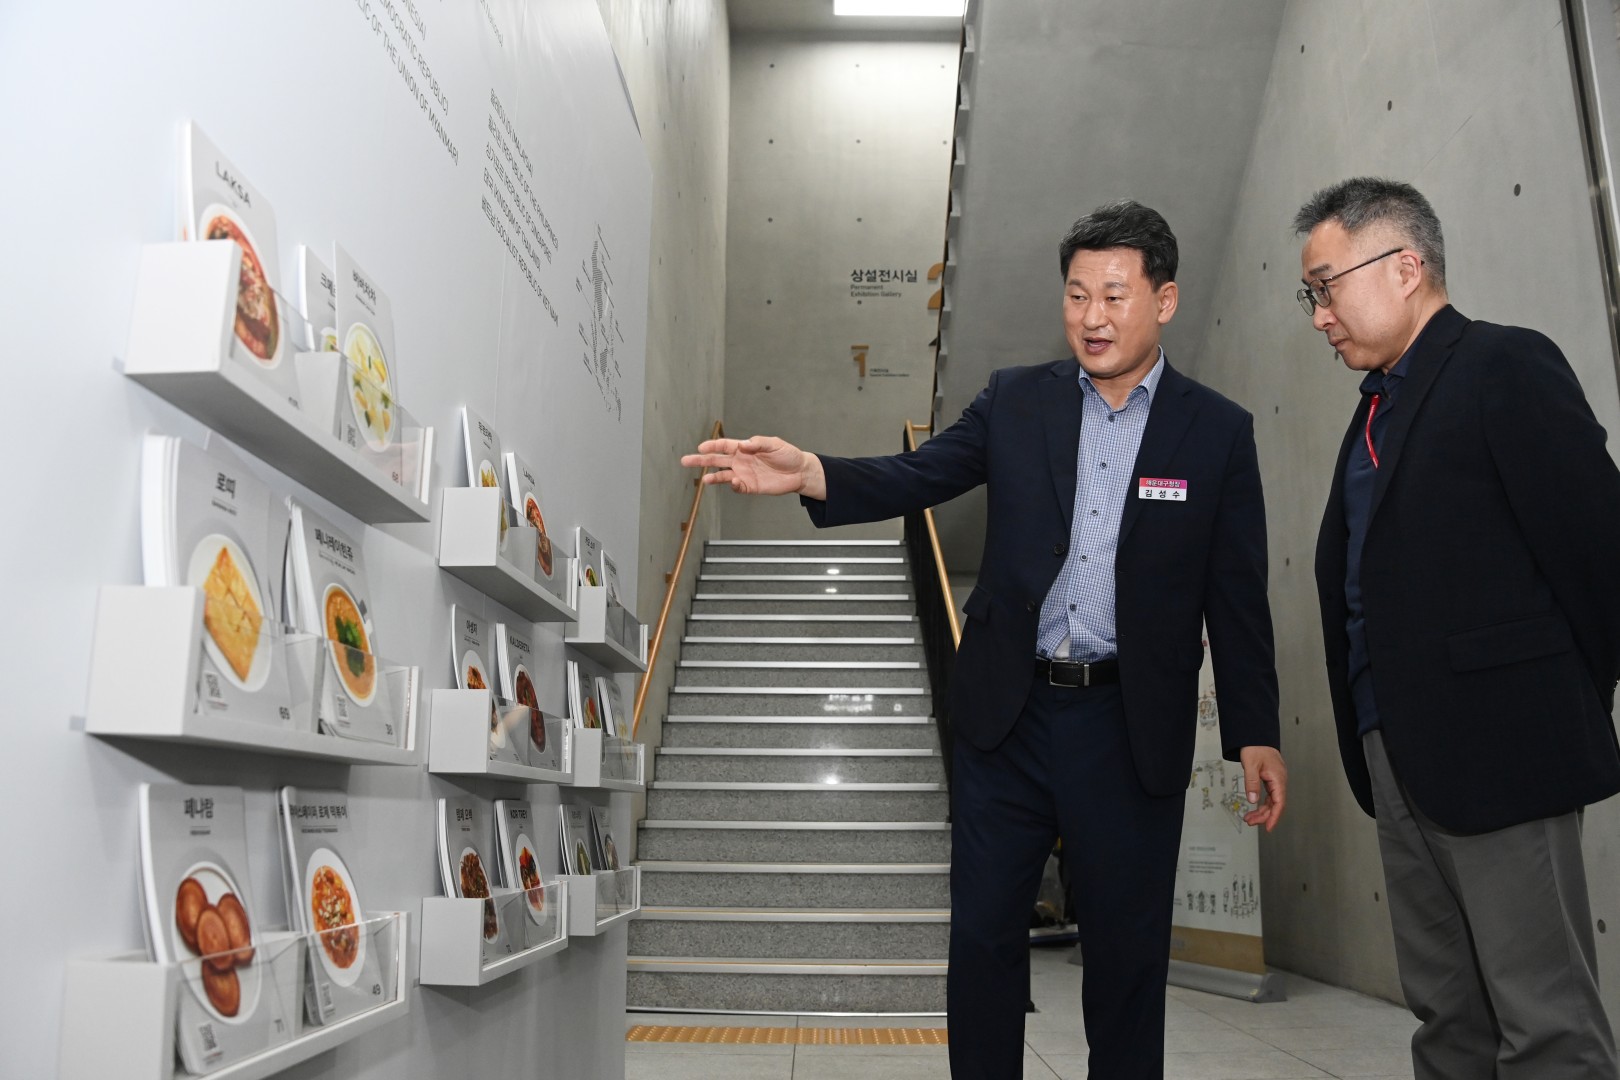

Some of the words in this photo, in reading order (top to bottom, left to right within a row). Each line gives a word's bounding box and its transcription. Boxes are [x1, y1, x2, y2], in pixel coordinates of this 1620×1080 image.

[372, 14, 382, 36] OF
[384, 30, 398, 65] THE
[398, 56, 419, 100] UNION
[420, 94, 429, 113] OF
[429, 108, 458, 166] MYANMAR)
[418, 53, 448, 116] REPUBLIC)
[215, 160, 251, 208] LAKSA
[850, 269, 918, 282] 상설전시실
